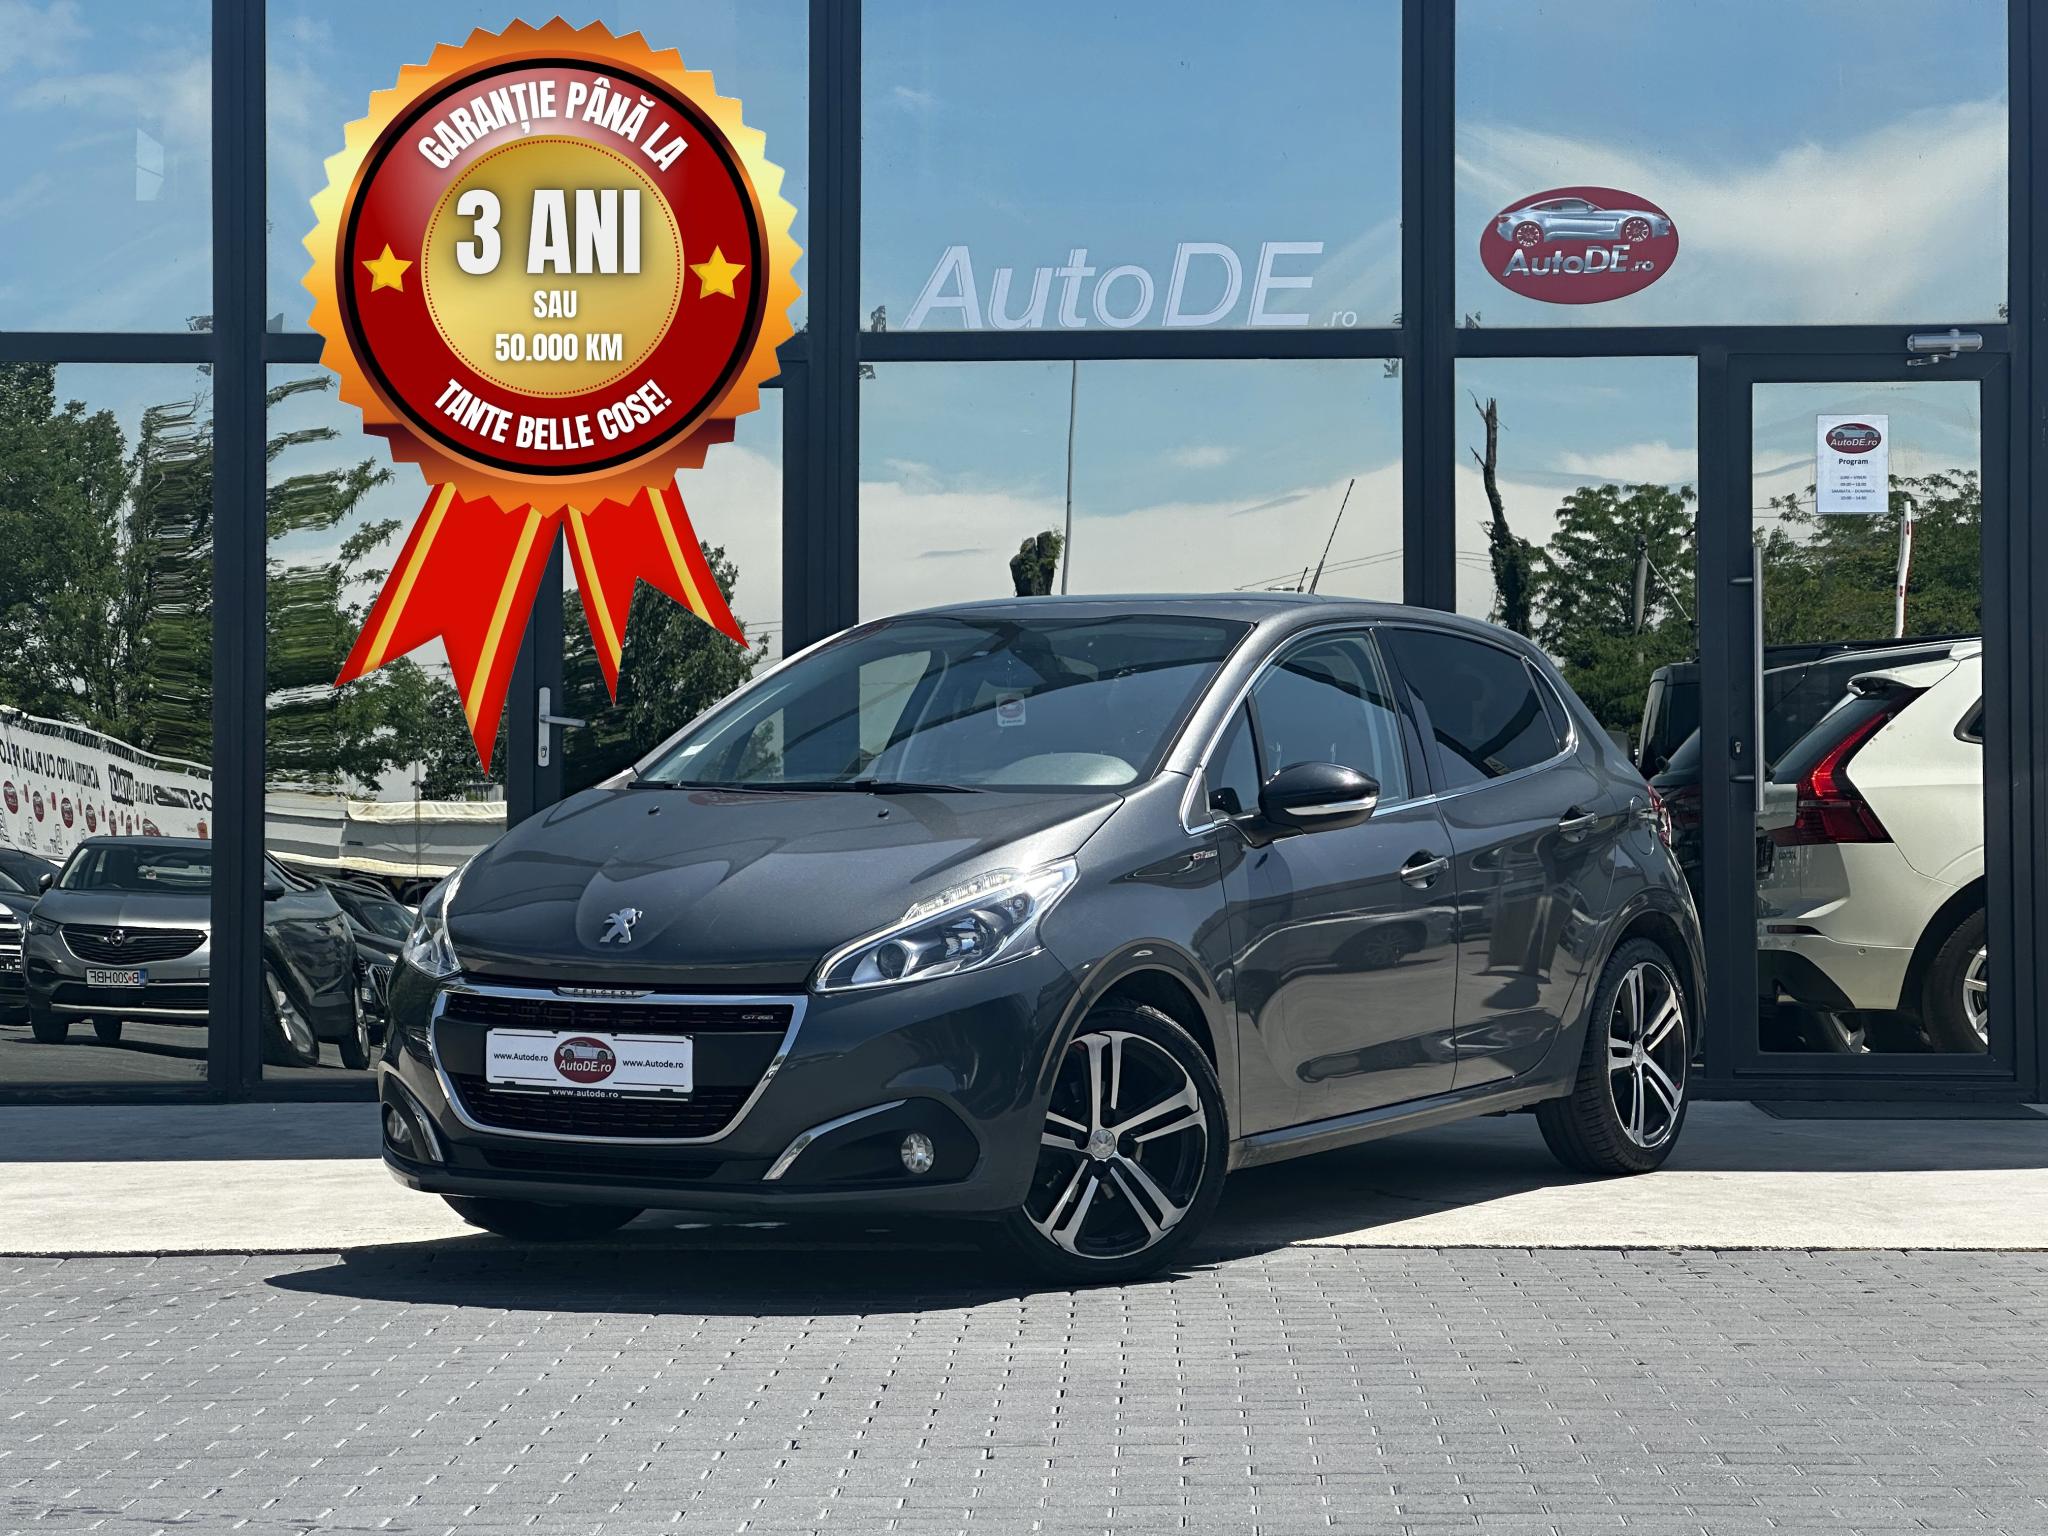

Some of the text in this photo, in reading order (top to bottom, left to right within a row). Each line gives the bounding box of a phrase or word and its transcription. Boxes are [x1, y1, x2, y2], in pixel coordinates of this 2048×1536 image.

[903, 242, 1324, 329] AutoDE
[1830, 438, 1878, 446] AutoDE.ro
[1838, 458, 1869, 466] Program
[573, 988, 637, 996] PEUGEOT
[493, 1052, 684, 1073] www.Autode.ro AutoDE.ro www.Autode.ro
[552, 1088, 619, 1098] www.autode.ro
